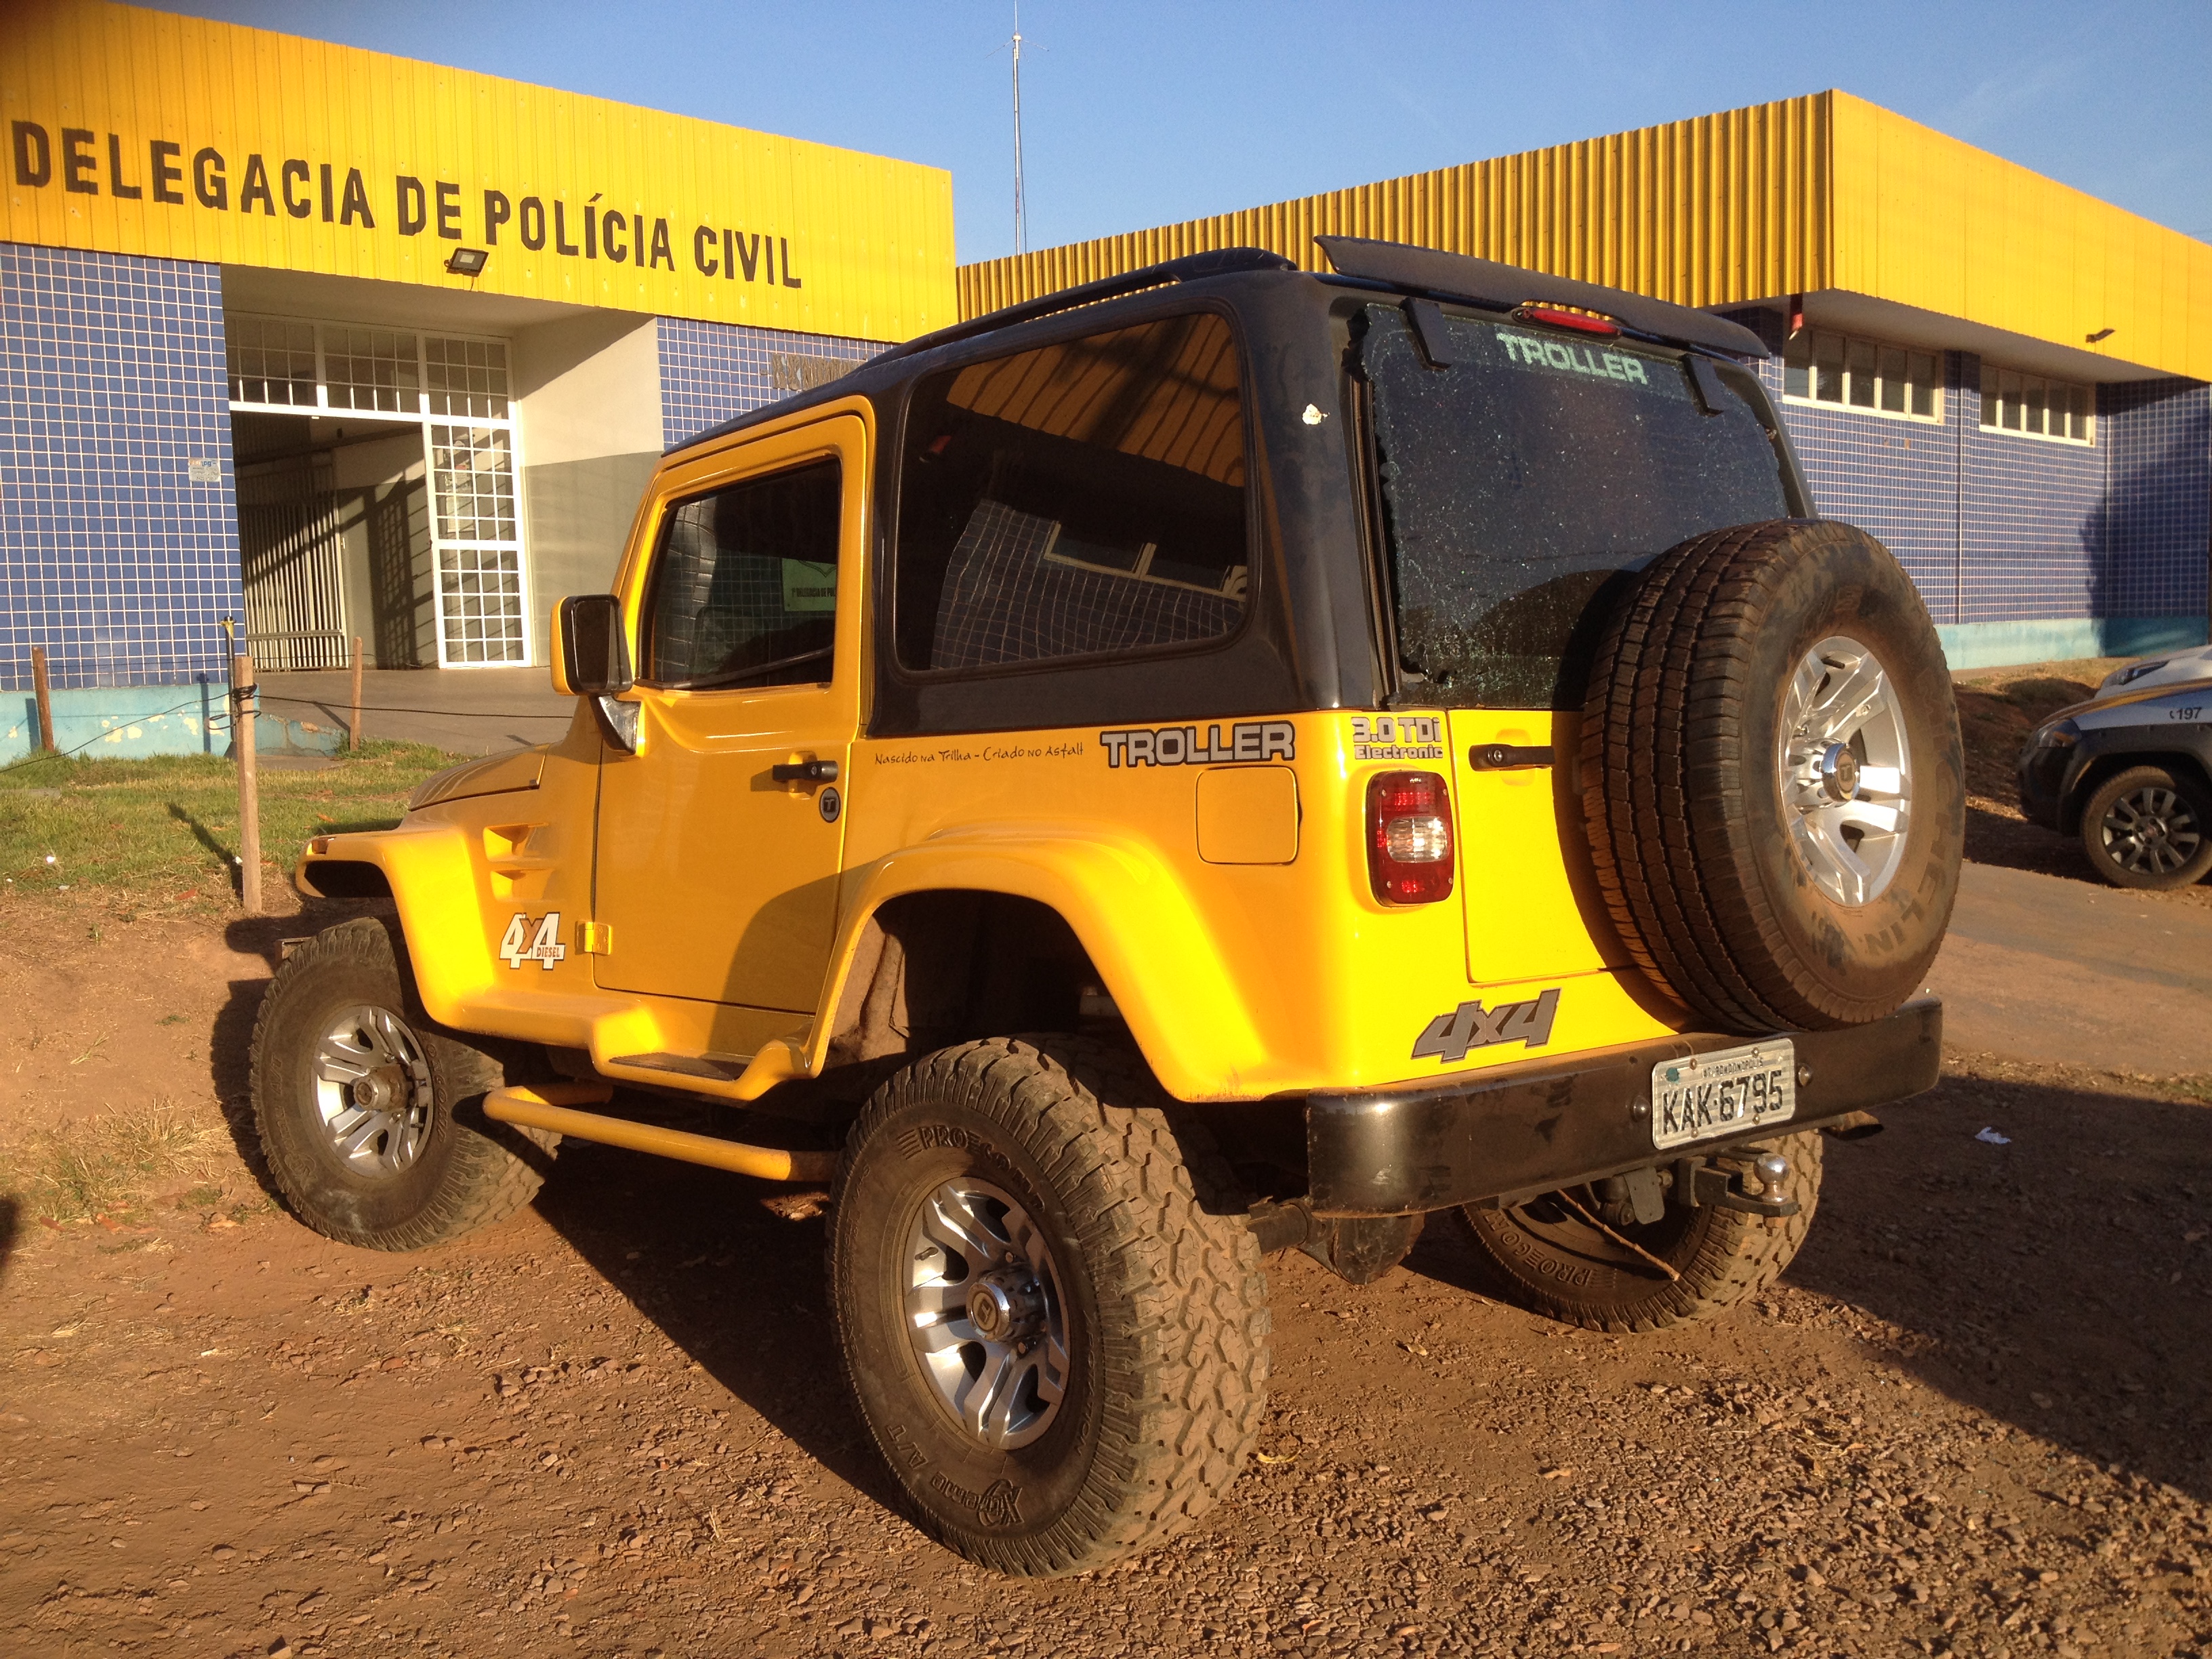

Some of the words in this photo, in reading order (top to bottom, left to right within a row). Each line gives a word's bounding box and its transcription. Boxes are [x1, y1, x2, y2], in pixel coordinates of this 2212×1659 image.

[11, 119, 376, 229] DELEGACIA
[396, 175, 462, 241] DE
[483, 189, 676, 272] POLÍCIA
[693, 224, 802, 289] CIVIL
[1496, 332, 1649, 385] TROLLER
[1351, 716, 1396, 743] 3.0
[2176, 706, 2203, 720] 197
[875, 750, 918, 765] Nascido
[938, 749, 972, 762] Trilha
[983, 745, 1025, 761] Criado
[1099, 720, 1295, 768] TROLLER
[1353, 743, 1443, 760] Electronic
[535, 946, 560, 958] DIESEL
[918, 1124, 969, 1150] PRO
[980, 1142, 1046, 1213] COMP
[1483, 1209, 1533, 1256] COM
[1538, 1258, 1593, 1287] PRO
[884, 1423, 929, 1470] A/T
